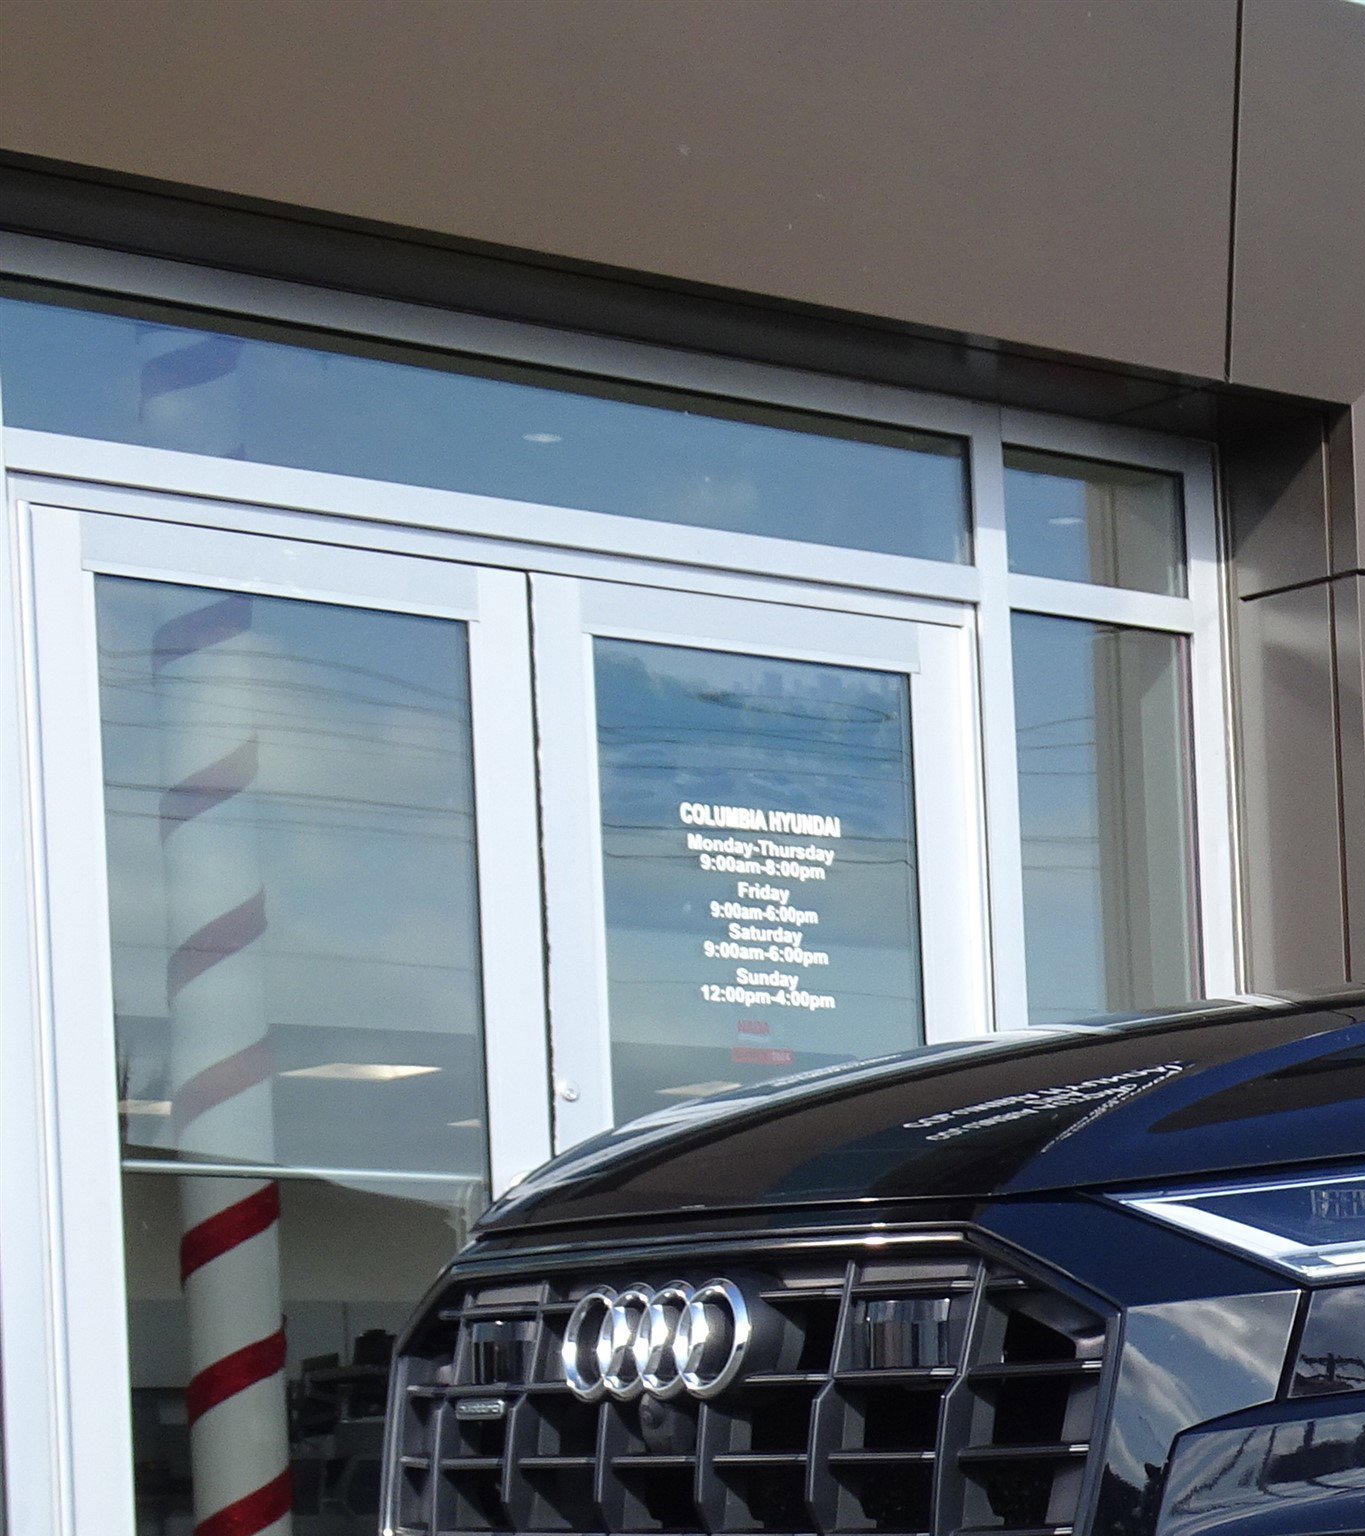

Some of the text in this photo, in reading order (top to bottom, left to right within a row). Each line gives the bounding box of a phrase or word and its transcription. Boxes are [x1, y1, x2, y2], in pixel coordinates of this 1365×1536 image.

[679, 802, 841, 838] COLUMBIA HYUNDAI
[687, 833, 835, 866] Monday-Thursday
[700, 853, 826, 882] 9:00am-8:00pm
[737, 881, 790, 905] Friday
[710, 900, 819, 926] 9:00am-6:00pm
[728, 922, 803, 947] Saturday
[703, 940, 830, 967] 9:00am-6:00pm
[736, 967, 799, 991] Sunday
[700, 984, 836, 1011] 12:00pm-4:00pm
